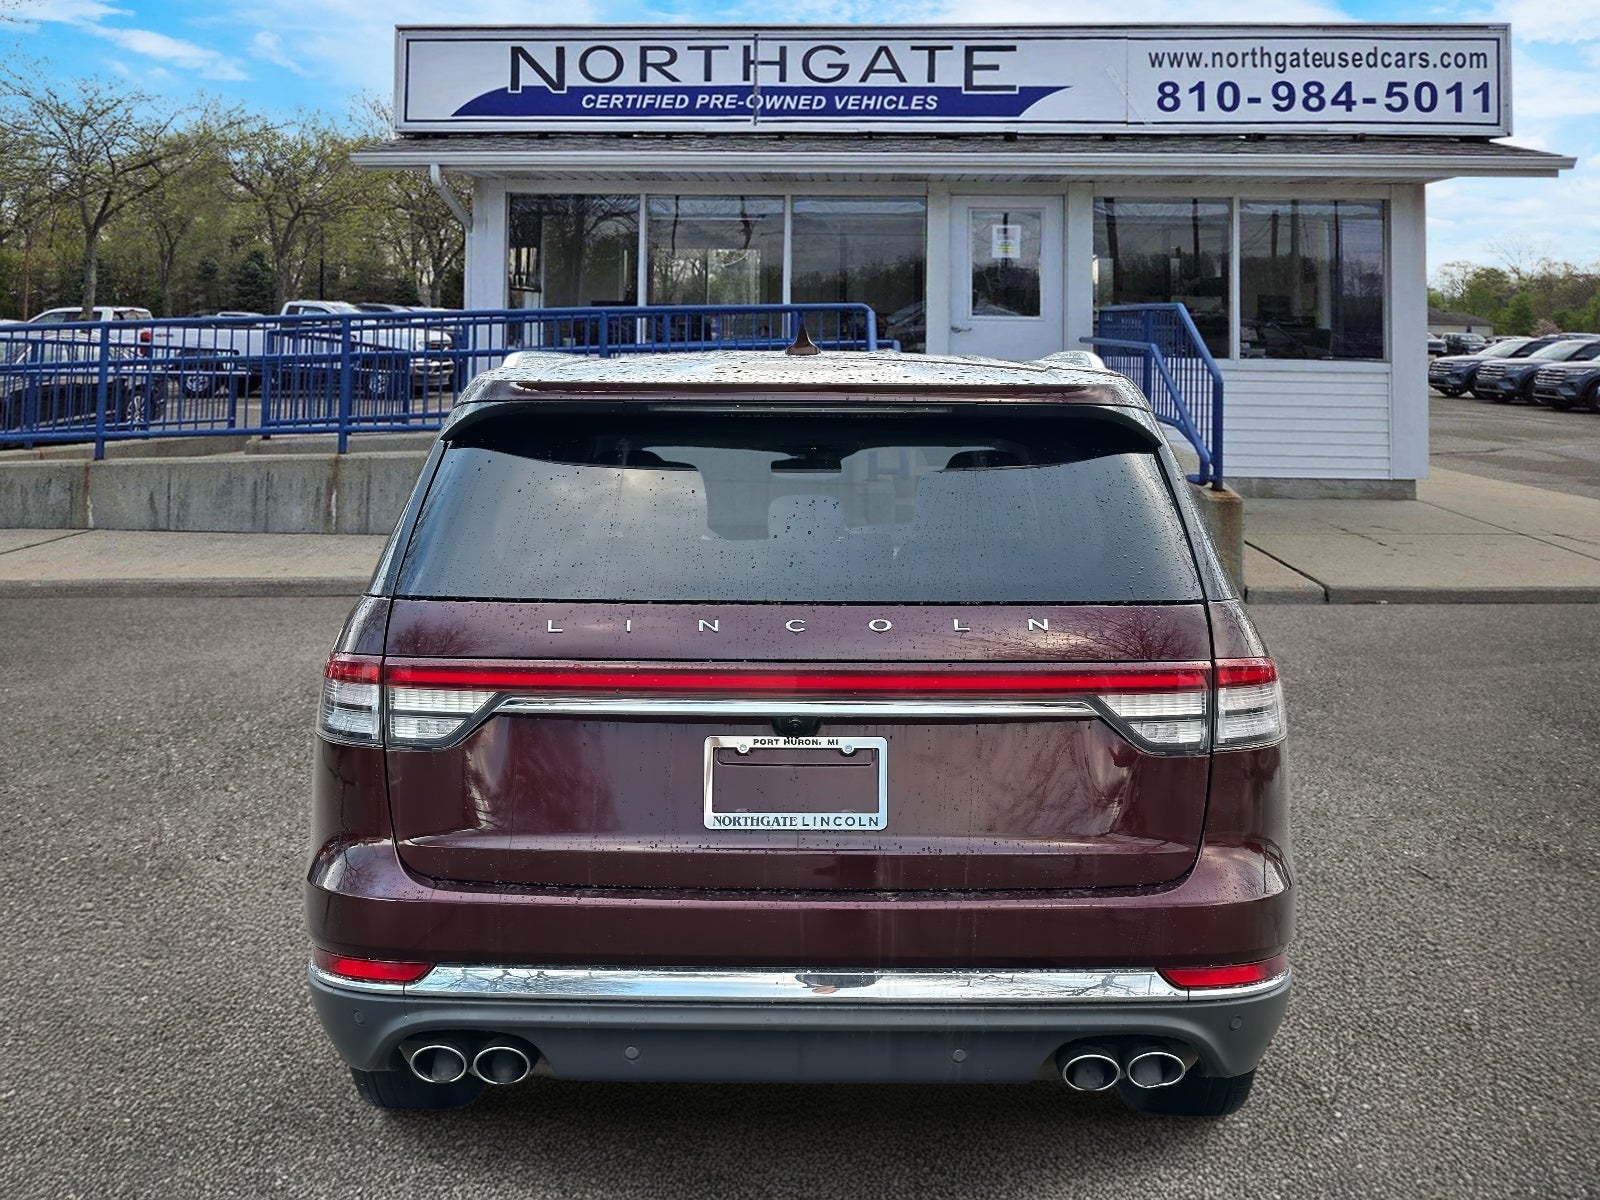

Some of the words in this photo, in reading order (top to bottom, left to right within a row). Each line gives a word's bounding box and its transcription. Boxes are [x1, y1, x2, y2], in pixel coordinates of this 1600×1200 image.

[1148, 46, 1488, 73] www.northgateusedcars.com
[510, 45, 1018, 92] NORTHGATE
[581, 94, 689, 109] CERTIFIED
[695, 95, 827, 110] PRE-OWNED
[834, 95, 939, 110] VEHICLES
[1156, 80, 1491, 113] 810-984-5011
[547, 618, 1049, 633] LINCOLN
[753, 738, 780, 746] PORT
[827, 738, 839, 746] MI
[712, 815, 798, 827] NORTHGATE
[801, 816, 879, 827] LINCOLN
